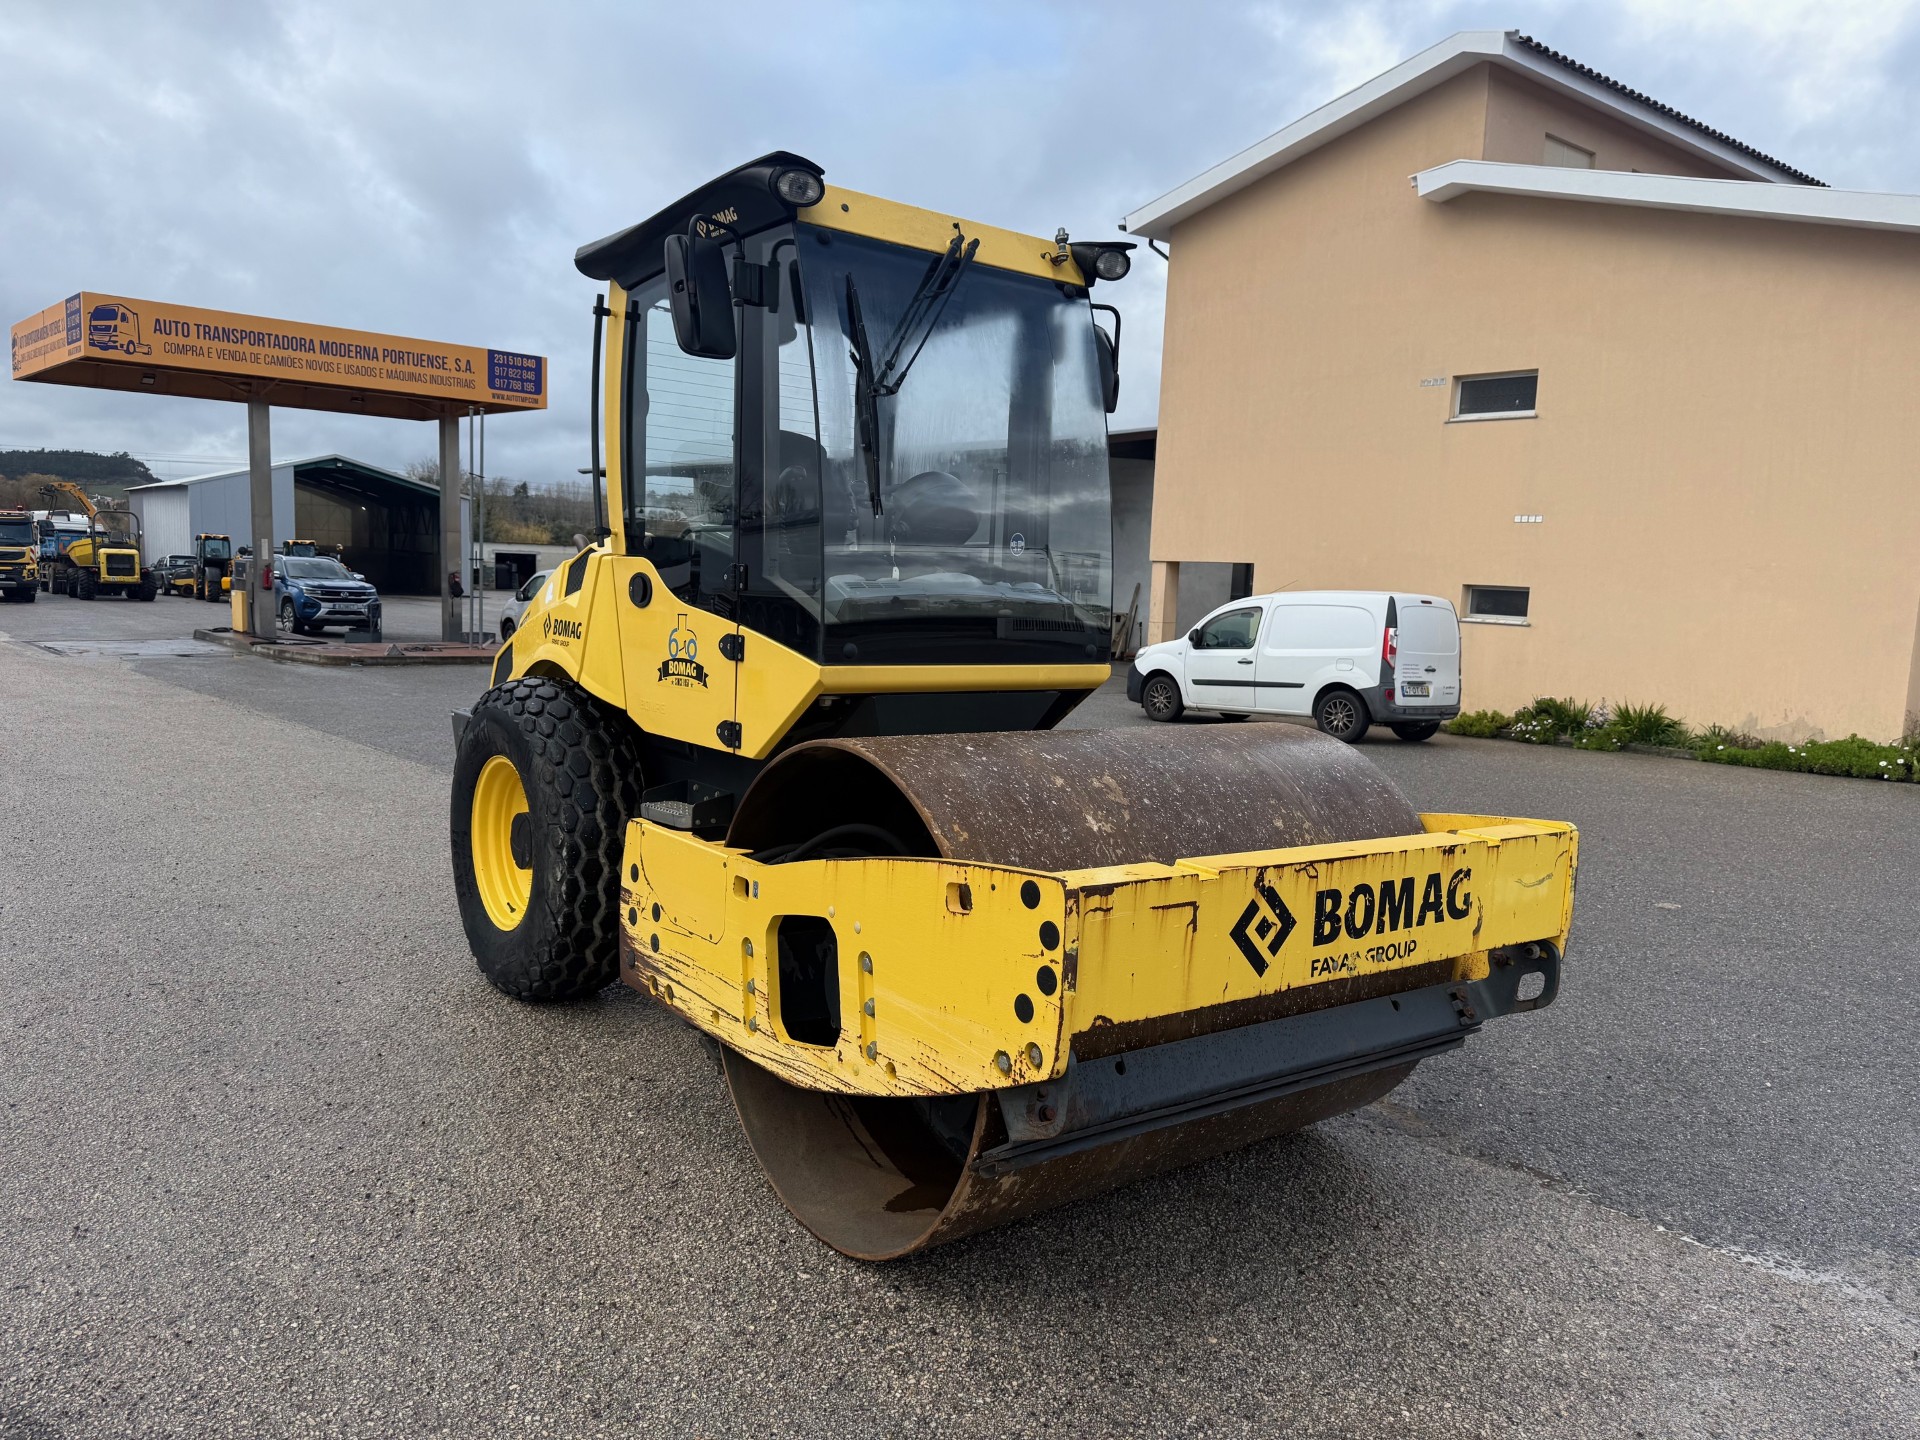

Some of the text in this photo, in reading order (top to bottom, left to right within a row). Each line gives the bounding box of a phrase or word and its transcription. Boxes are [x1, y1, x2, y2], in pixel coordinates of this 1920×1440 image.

[153, 318, 475, 374] AUTO TRANSPORTADORA MODERNA PORTUENSE, S.A.
[163, 342, 476, 390] COMPRA E VENDA DE CAMIÕES NOVOS E USADOS E MÁQUINAS INDUSTRIAIS
[494, 353, 507, 364] 231
[508, 355, 522, 366] 510
[494, 366, 507, 376] 917
[494, 378, 508, 389] 917
[523, 382, 535, 392] 195
[553, 618, 583, 640] BOMAG
[668, 660, 697, 677] BOMAG
[1313, 867, 1472, 947] BOMAG
[1311, 940, 1417, 977] FAYA GROUP
